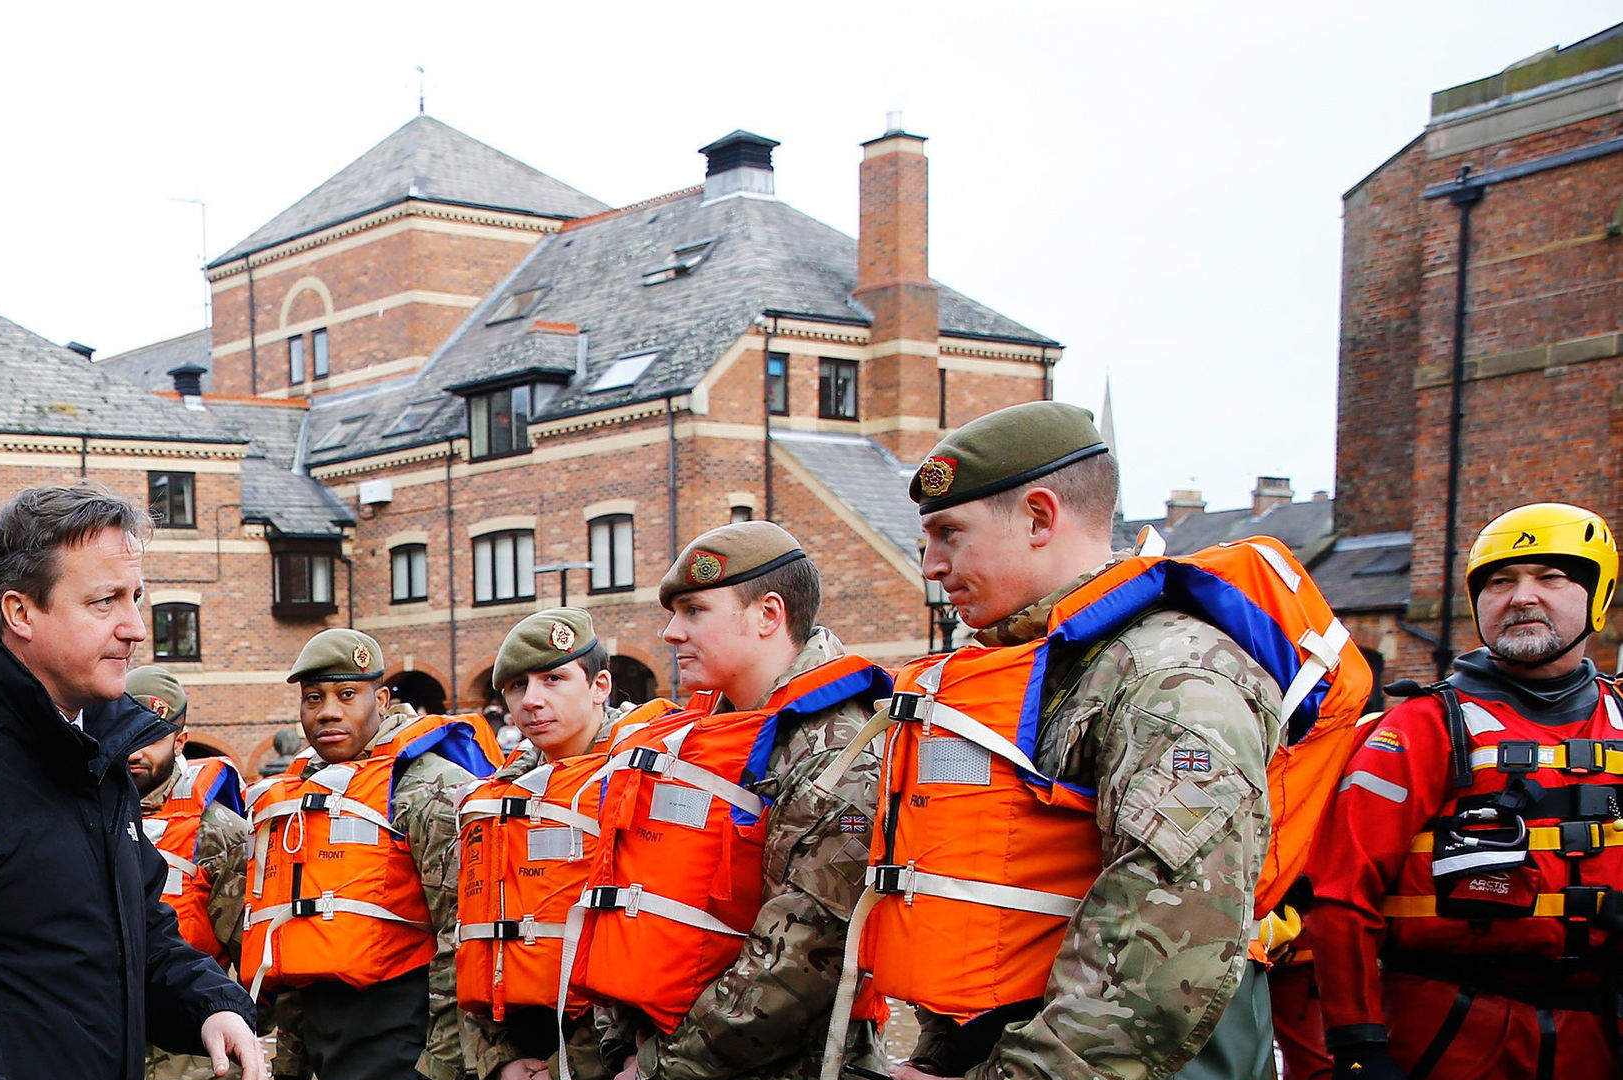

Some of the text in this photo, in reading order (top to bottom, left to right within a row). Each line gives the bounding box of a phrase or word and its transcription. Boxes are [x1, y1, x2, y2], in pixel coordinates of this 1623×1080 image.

[910, 794, 930, 808] FRONT
[636, 827, 664, 842] FRONT
[318, 850, 345, 859] FRONT
[518, 867, 545, 877] FRONT
[1469, 879, 1510, 890] ARCTIC
